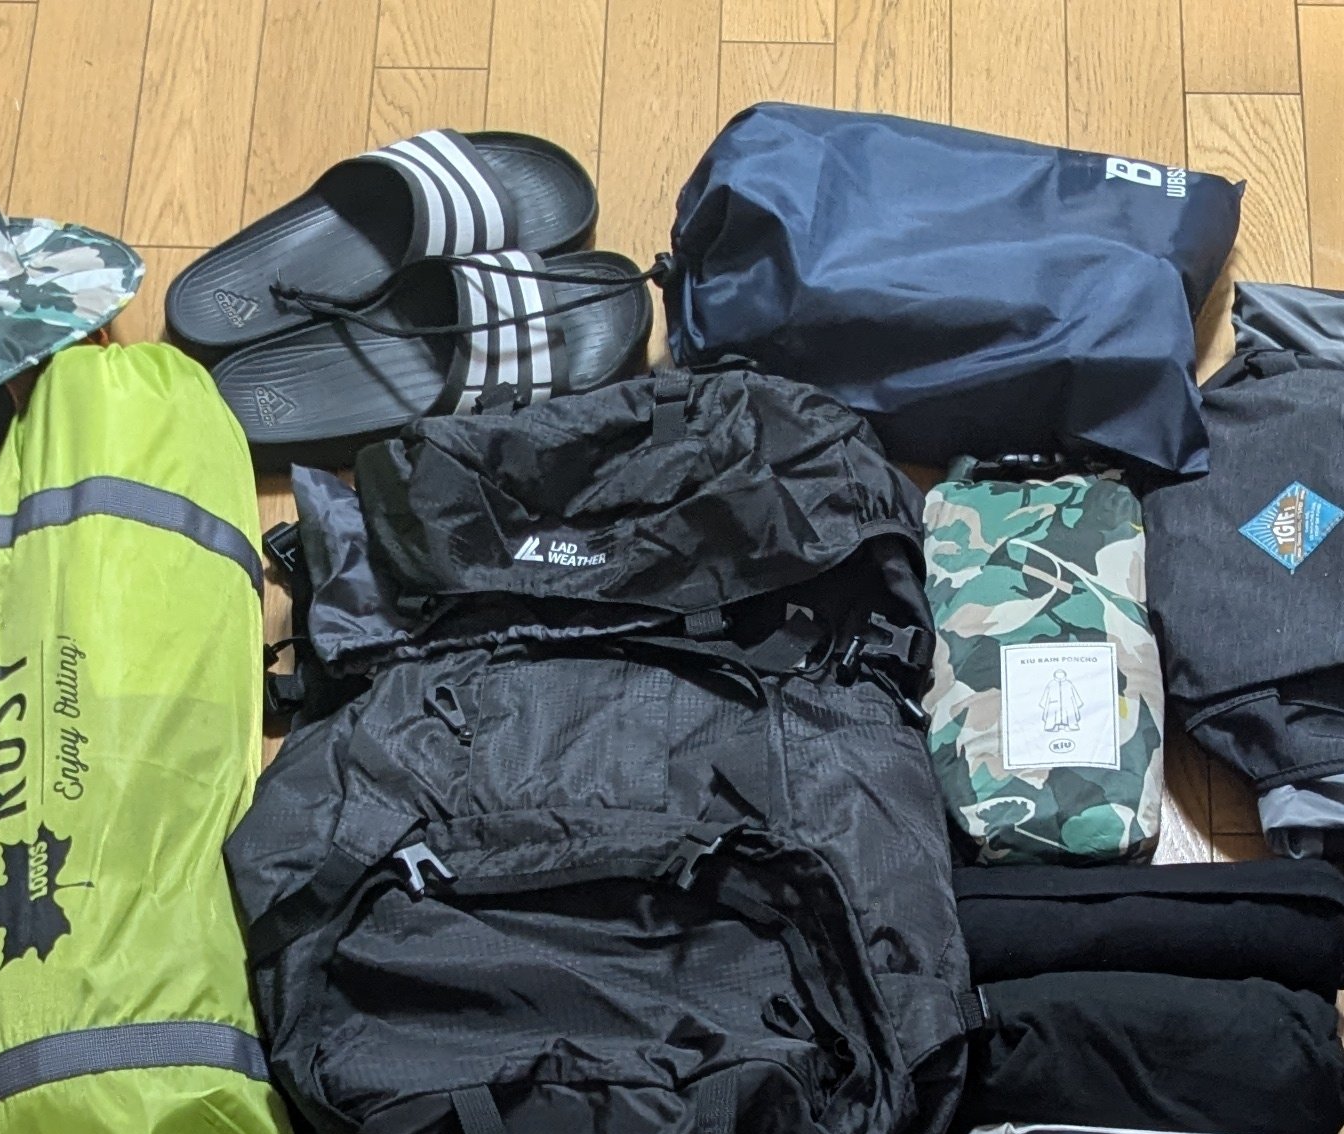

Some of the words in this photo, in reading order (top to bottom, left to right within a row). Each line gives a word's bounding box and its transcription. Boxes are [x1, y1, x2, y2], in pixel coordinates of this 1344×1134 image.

[548, 552, 606, 567] WEATHER
[551, 541, 577, 554] LAD
[54, 726, 89, 801] Enjoy
[29, 841, 47, 901] LOGOS
